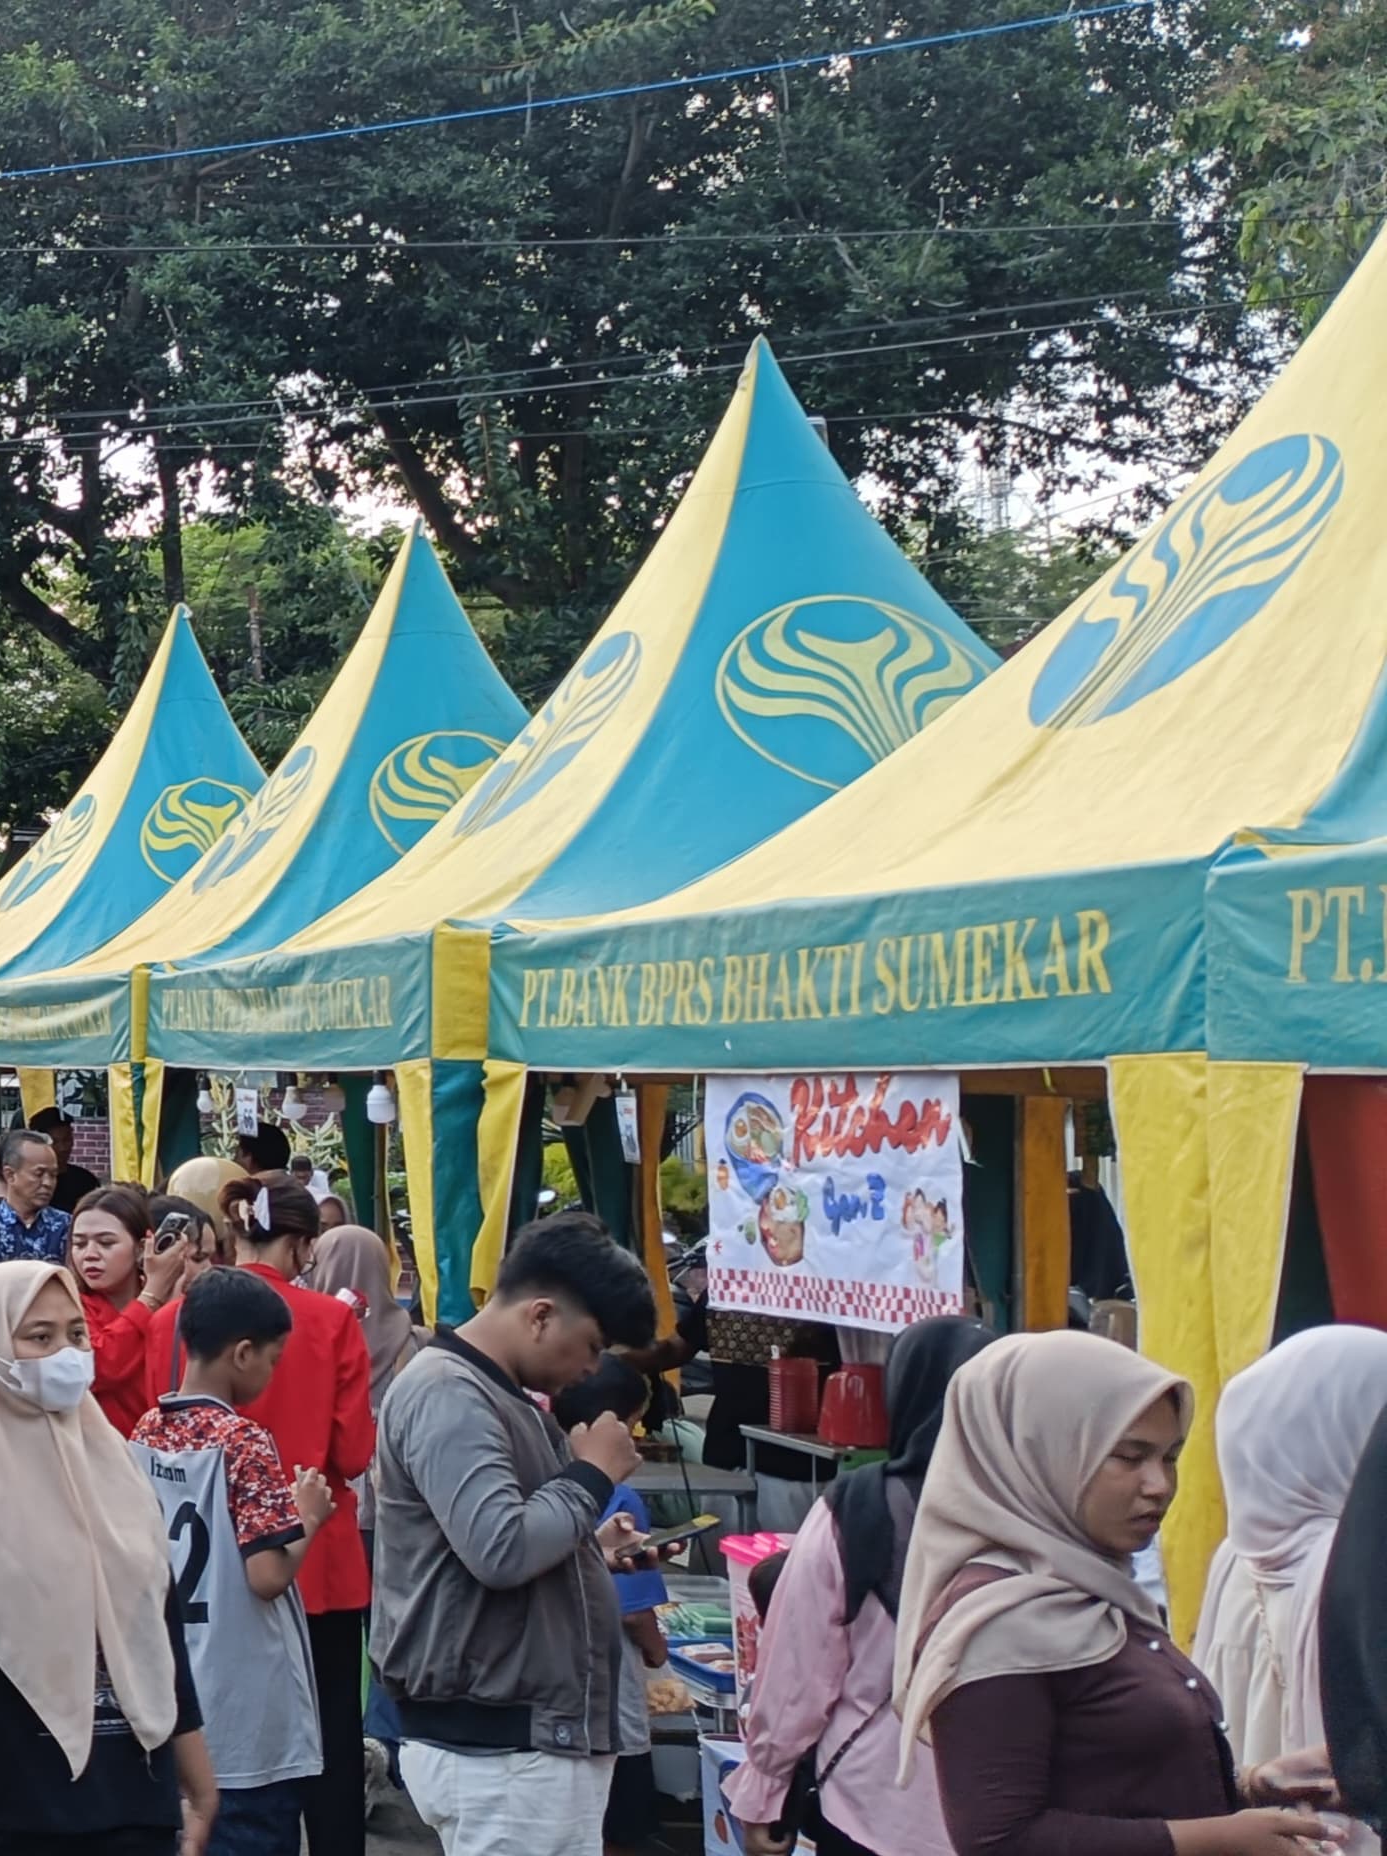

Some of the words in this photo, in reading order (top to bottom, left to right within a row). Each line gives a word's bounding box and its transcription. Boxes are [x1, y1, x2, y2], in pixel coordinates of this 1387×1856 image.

[518, 963, 634, 1029] PT.BANK
[637, 957, 716, 1027] BPRS
[720, 941, 866, 1024] BHAKTI
[872, 908, 1113, 1015] SUMEKAR
